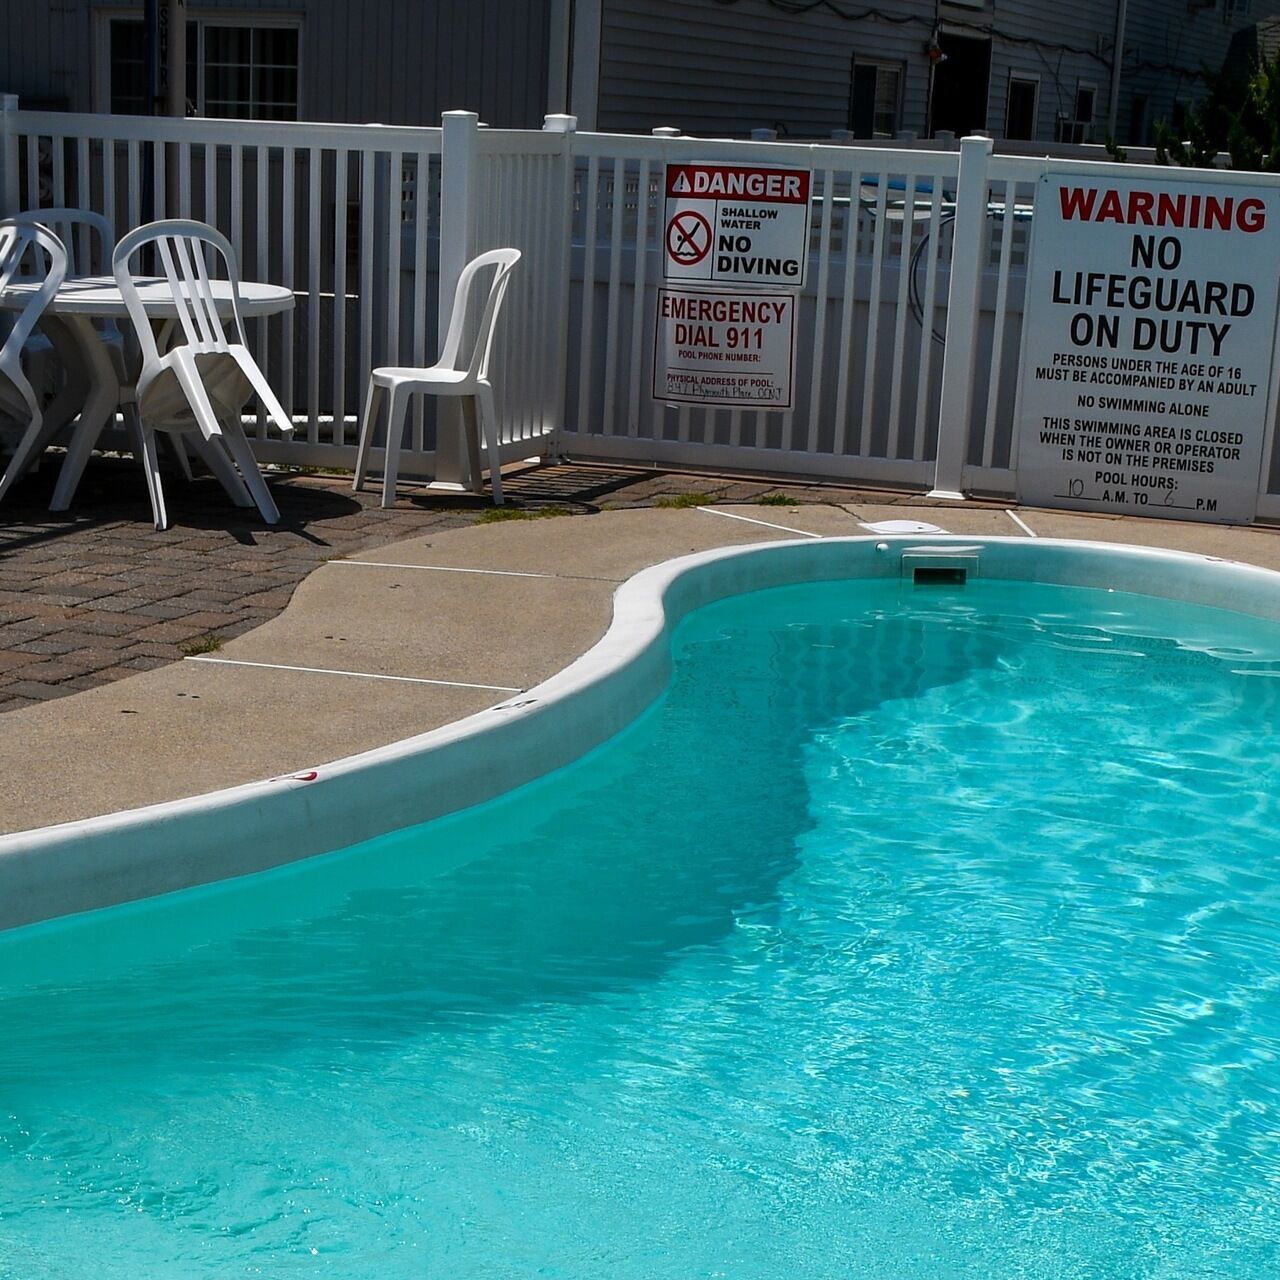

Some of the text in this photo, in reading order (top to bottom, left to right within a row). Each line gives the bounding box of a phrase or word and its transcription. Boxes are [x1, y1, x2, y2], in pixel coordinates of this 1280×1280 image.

[694, 171, 801, 198] DANGER
[721, 207, 778, 220] SHALLOW
[1059, 186, 1267, 233] WARNING
[720, 219, 761, 230] WATER
[719, 235, 752, 253] NO
[1130, 234, 1182, 270] NO
[717, 256, 799, 276] DIVING
[1052, 270, 1255, 318] LIFEGUARD
[662, 296, 786, 324] EMERGENCY
[675, 324, 762, 349] DIAL 911
[1070, 312, 1232, 357] ON DUTY
[678, 350, 760, 362] POOL PHONE NUMBER:
[1052, 353, 1242, 379] PERSONS UNDER THE AGE OF 16
[667, 373, 774, 388] PHYSICAL ADDRESS OF POOL:
[1036, 367, 1257, 396] MUST BE ACCOMPANIED BY AN ADULT
[1077, 394, 1210, 417] NO SWIMMING ALONE
[1043, 416, 1243, 445] THIS SWIMMING AREA IS CLOSED
[1040, 432, 1240, 460] WHEN THE OWNER OR OPERATOR
[1062, 448, 1214, 473] IS NOT ON THE PREMISES
[1095, 471, 1178, 490] POOL HOURS:
[1068, 478, 1084, 497] 10
[1102, 490, 1129, 504] A.M.
[1134, 492, 1148, 505] TO
[1195, 498, 1217, 512] P.M
